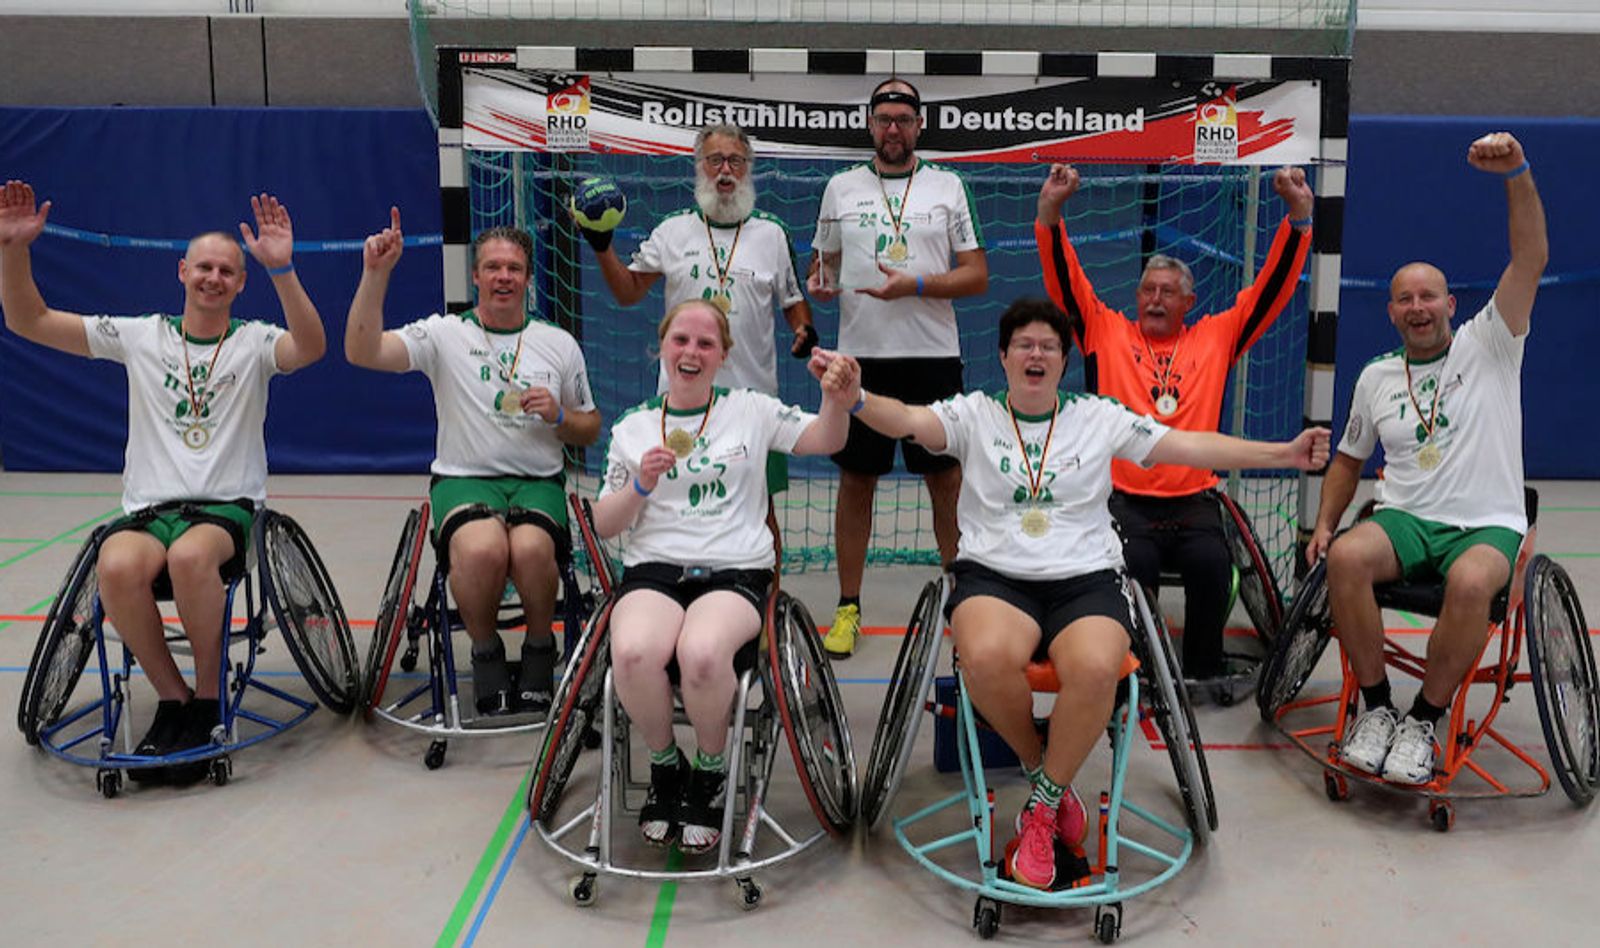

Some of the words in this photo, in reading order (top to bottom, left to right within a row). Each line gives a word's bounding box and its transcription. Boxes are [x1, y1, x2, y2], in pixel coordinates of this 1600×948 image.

[547, 115, 586, 130] RHD
[939, 106, 1145, 132] Deutschland
[1197, 126, 1235, 140] RHD
[690, 264, 699, 279] 4
[481, 365, 491, 381] 8
[164, 373, 180, 391] 11
[1000, 456, 1011, 474] 6
